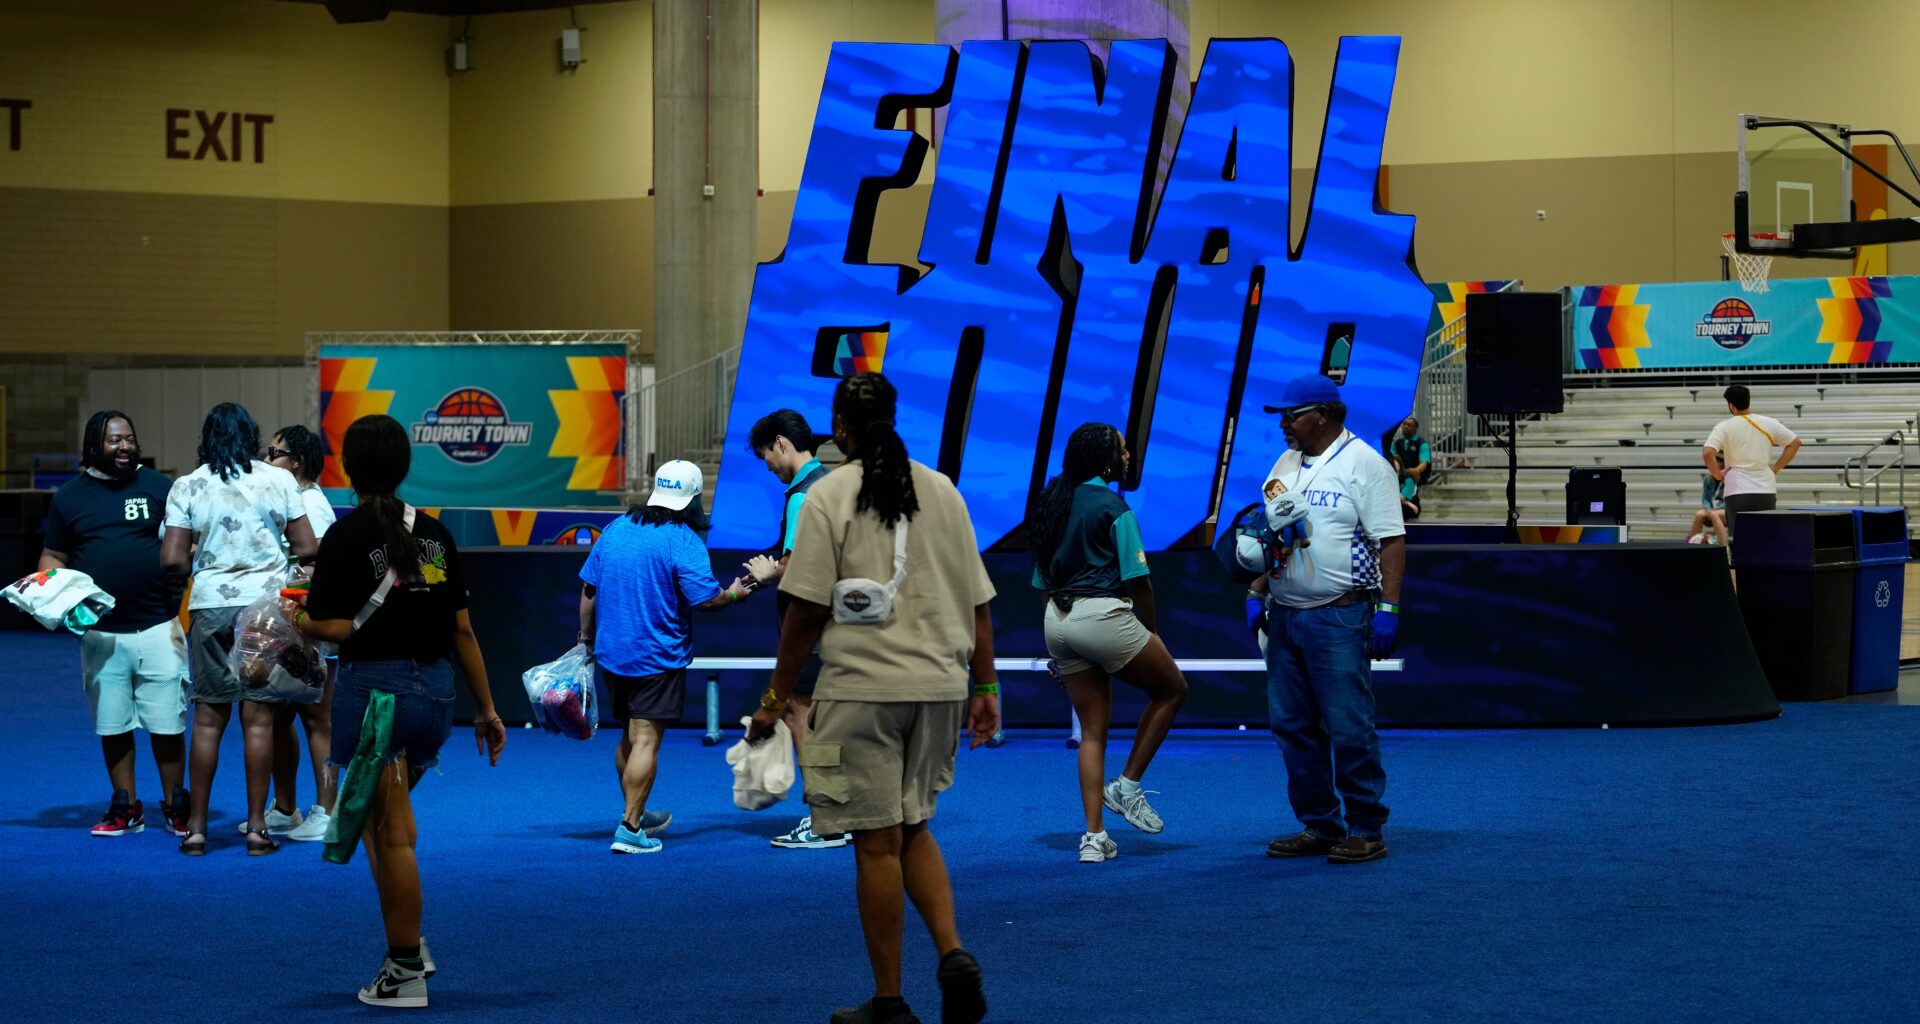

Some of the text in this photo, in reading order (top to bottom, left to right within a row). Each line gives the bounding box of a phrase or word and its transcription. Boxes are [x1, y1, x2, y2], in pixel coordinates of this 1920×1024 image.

[166, 108, 274, 163] EXIT
[780, 36, 1416, 265] FINAL
[1697, 322, 1769, 335] TOURNEY TOWN
[414, 425, 529, 442] TOURNEY TOWN
[657, 477, 682, 490] UCLA
[124, 503, 149, 520] 81
